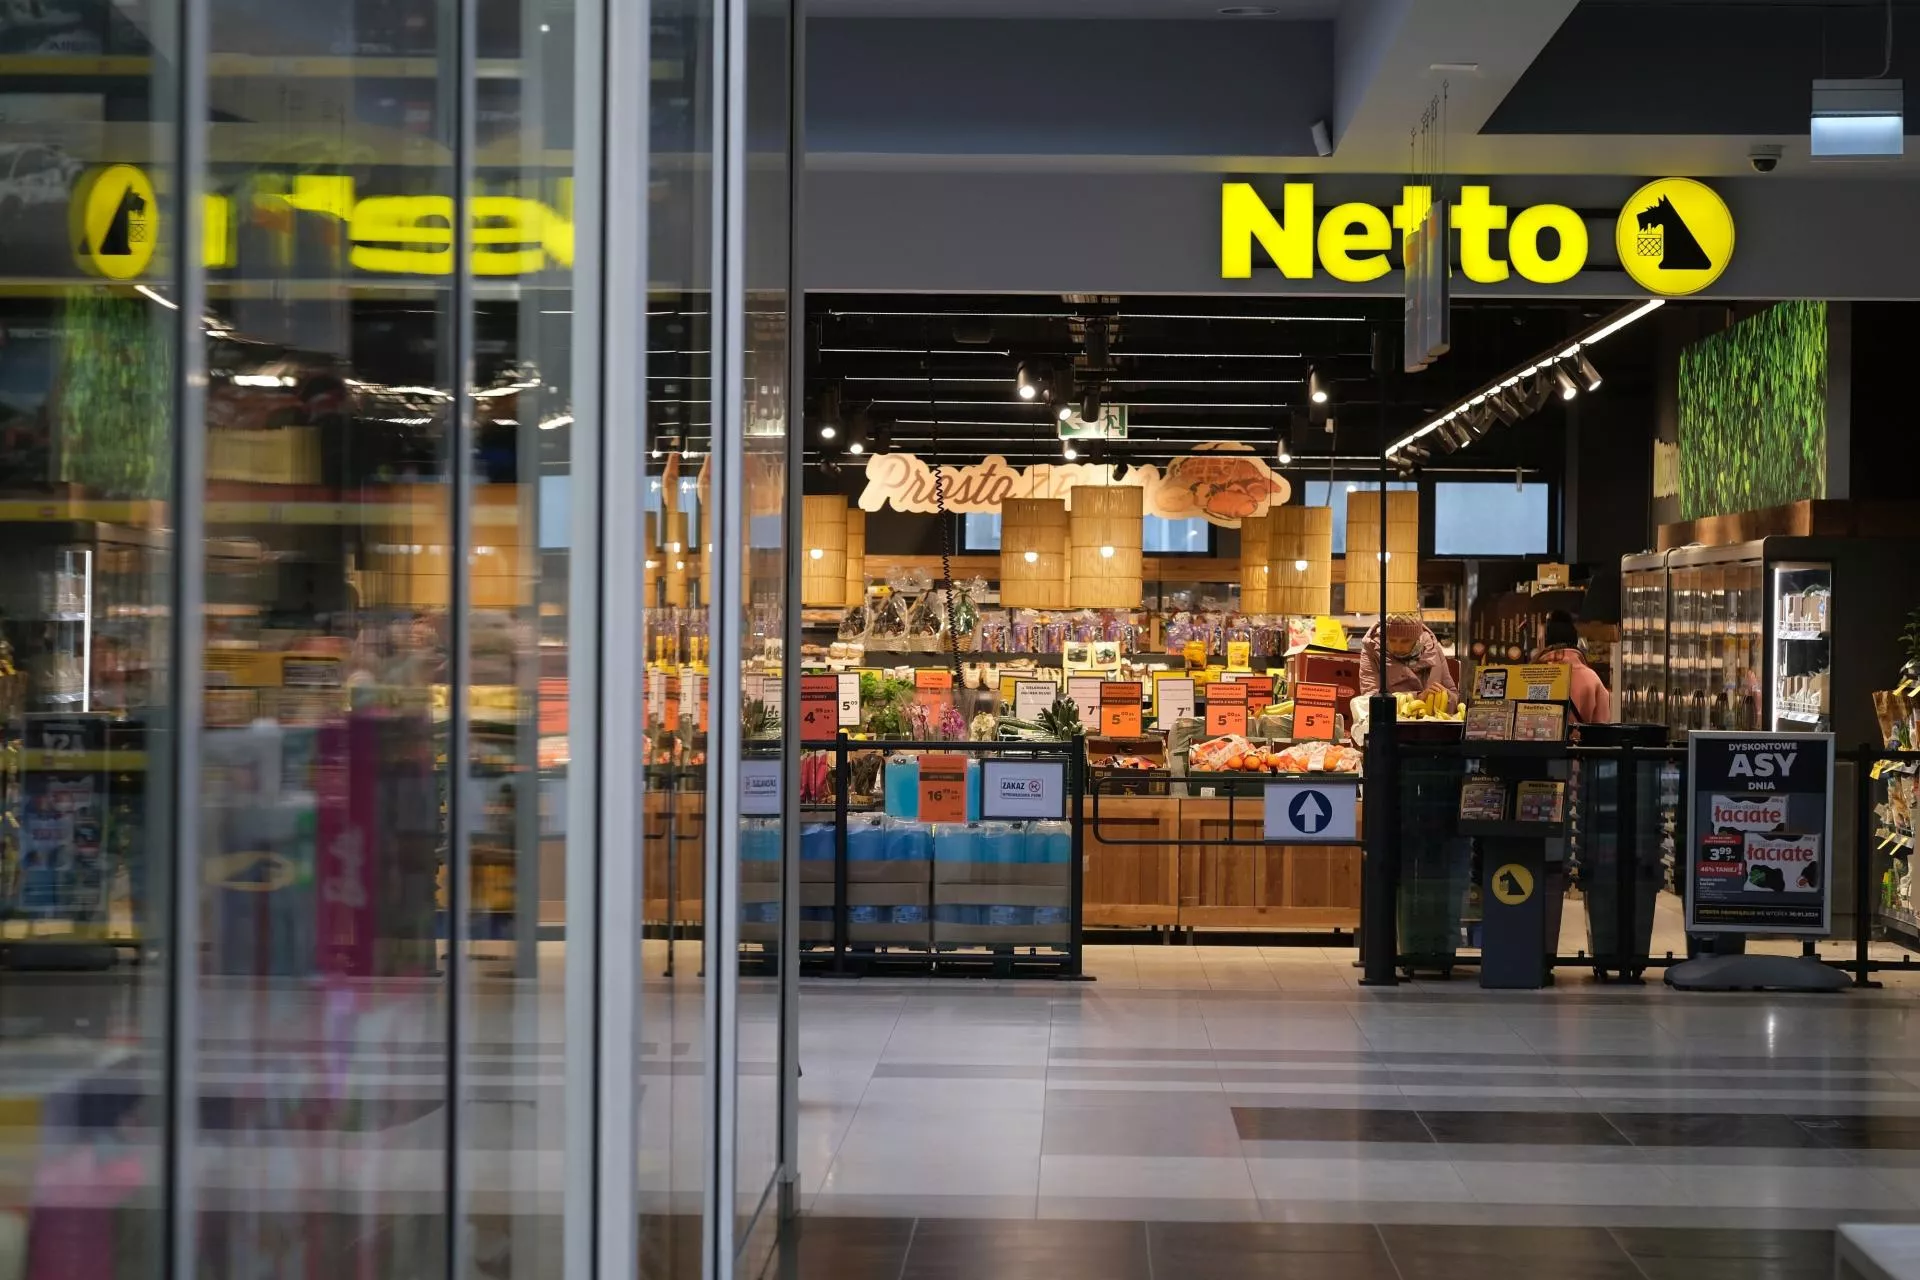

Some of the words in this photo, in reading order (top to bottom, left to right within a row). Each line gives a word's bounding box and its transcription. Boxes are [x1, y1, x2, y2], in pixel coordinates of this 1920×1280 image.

[876, 455, 1016, 505] Prosto
[1728, 742, 1798, 751] DYSKONTOWE
[1727, 752, 1798, 777] ASY
[1002, 781, 1025, 790] ZAKAZ
[1748, 782, 1776, 790] DNIA
[1714, 805, 1782, 823] łaciate
[1747, 843, 1814, 862] łaciate
